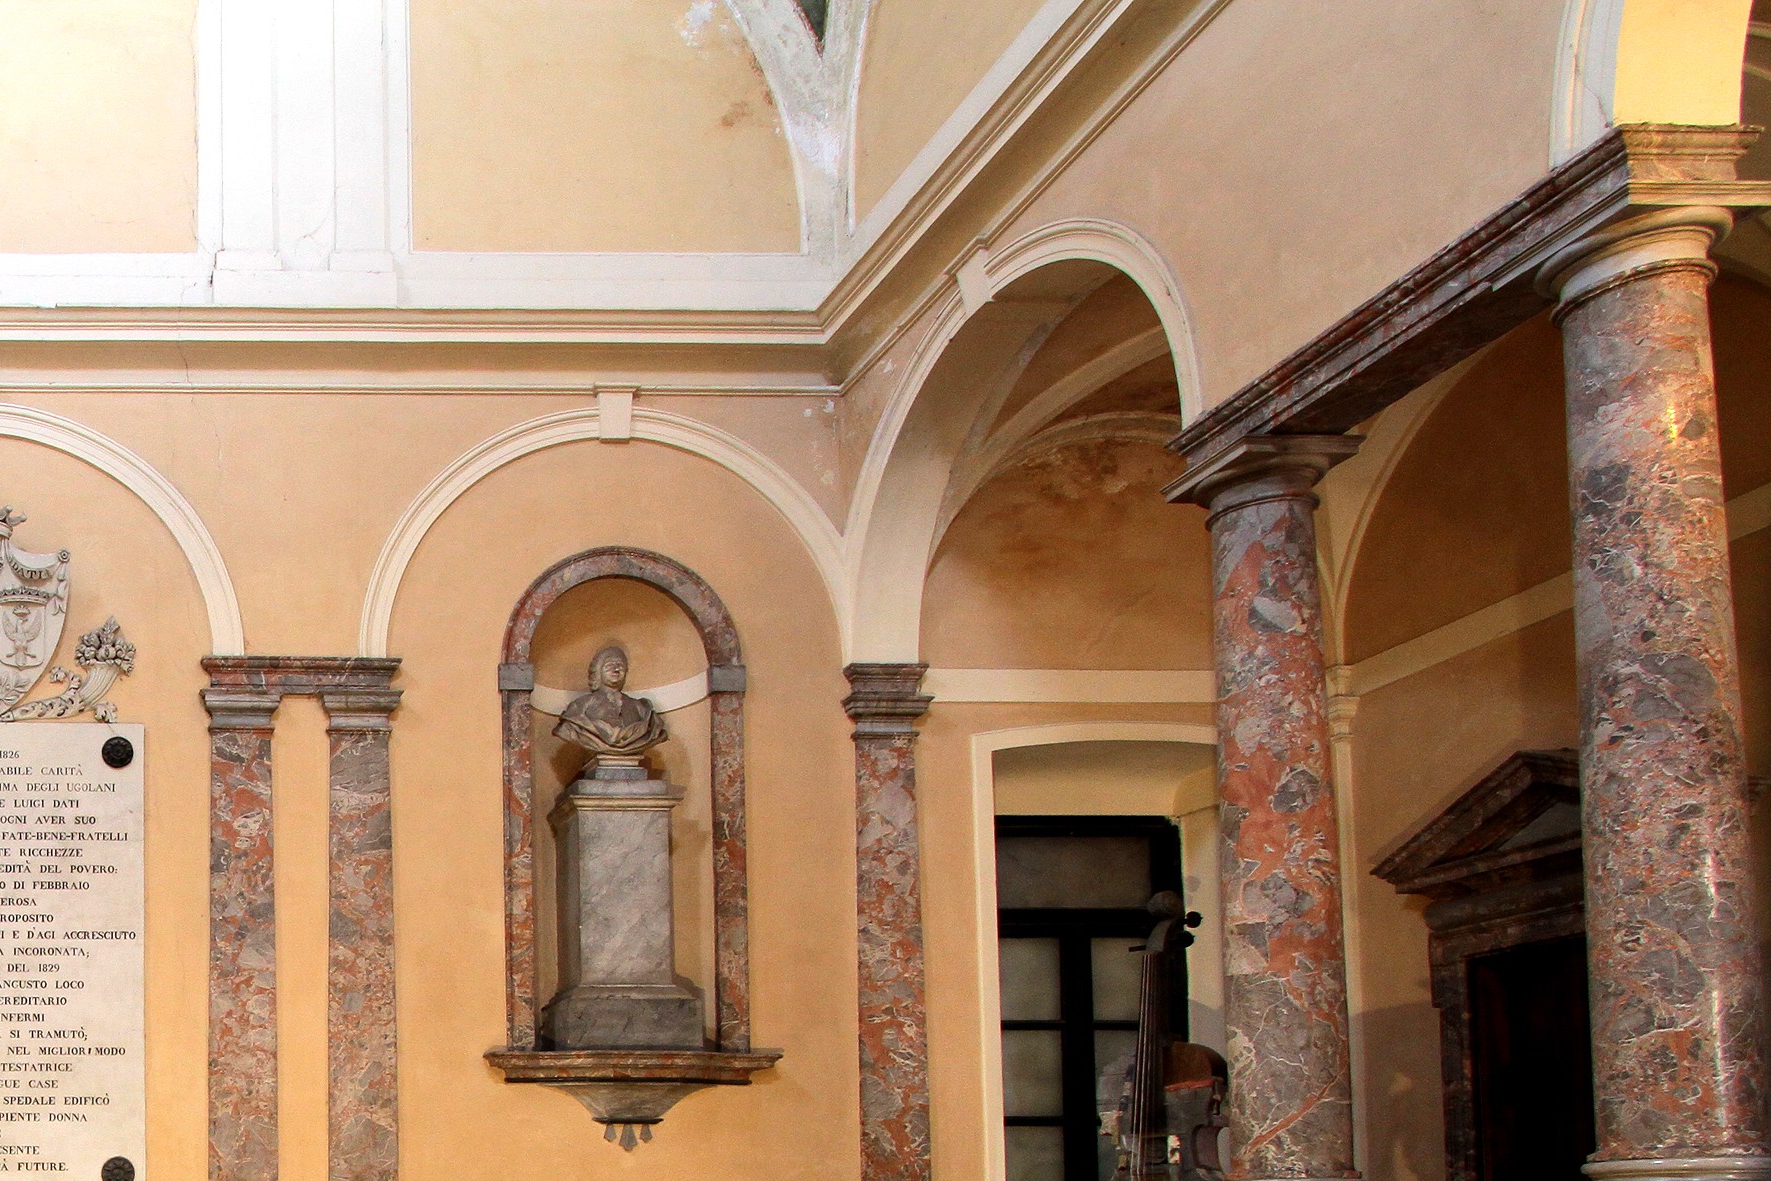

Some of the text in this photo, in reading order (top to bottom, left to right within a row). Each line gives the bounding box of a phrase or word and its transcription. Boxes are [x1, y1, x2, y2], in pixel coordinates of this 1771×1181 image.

[26, 782, 59, 792] DEGLI
[66, 783, 116, 793] UGOLANI
[13, 799, 45, 809] LUIGI
[52, 799, 80, 809] DATI
[0, 815, 27, 825] OGNI
[34, 815, 67, 825] AVER
[73, 816, 97, 826] SUO
[1, 832, 128, 842] FATE-BENE-FRATELLI
[39, 865, 63, 874] DEL
[7, 964, 30, 973] DEL
[38, 964, 61, 973] 1829
[0, 1062, 73, 1073] TESTATRICE
[48, 1112, 88, 1123] DONNA
